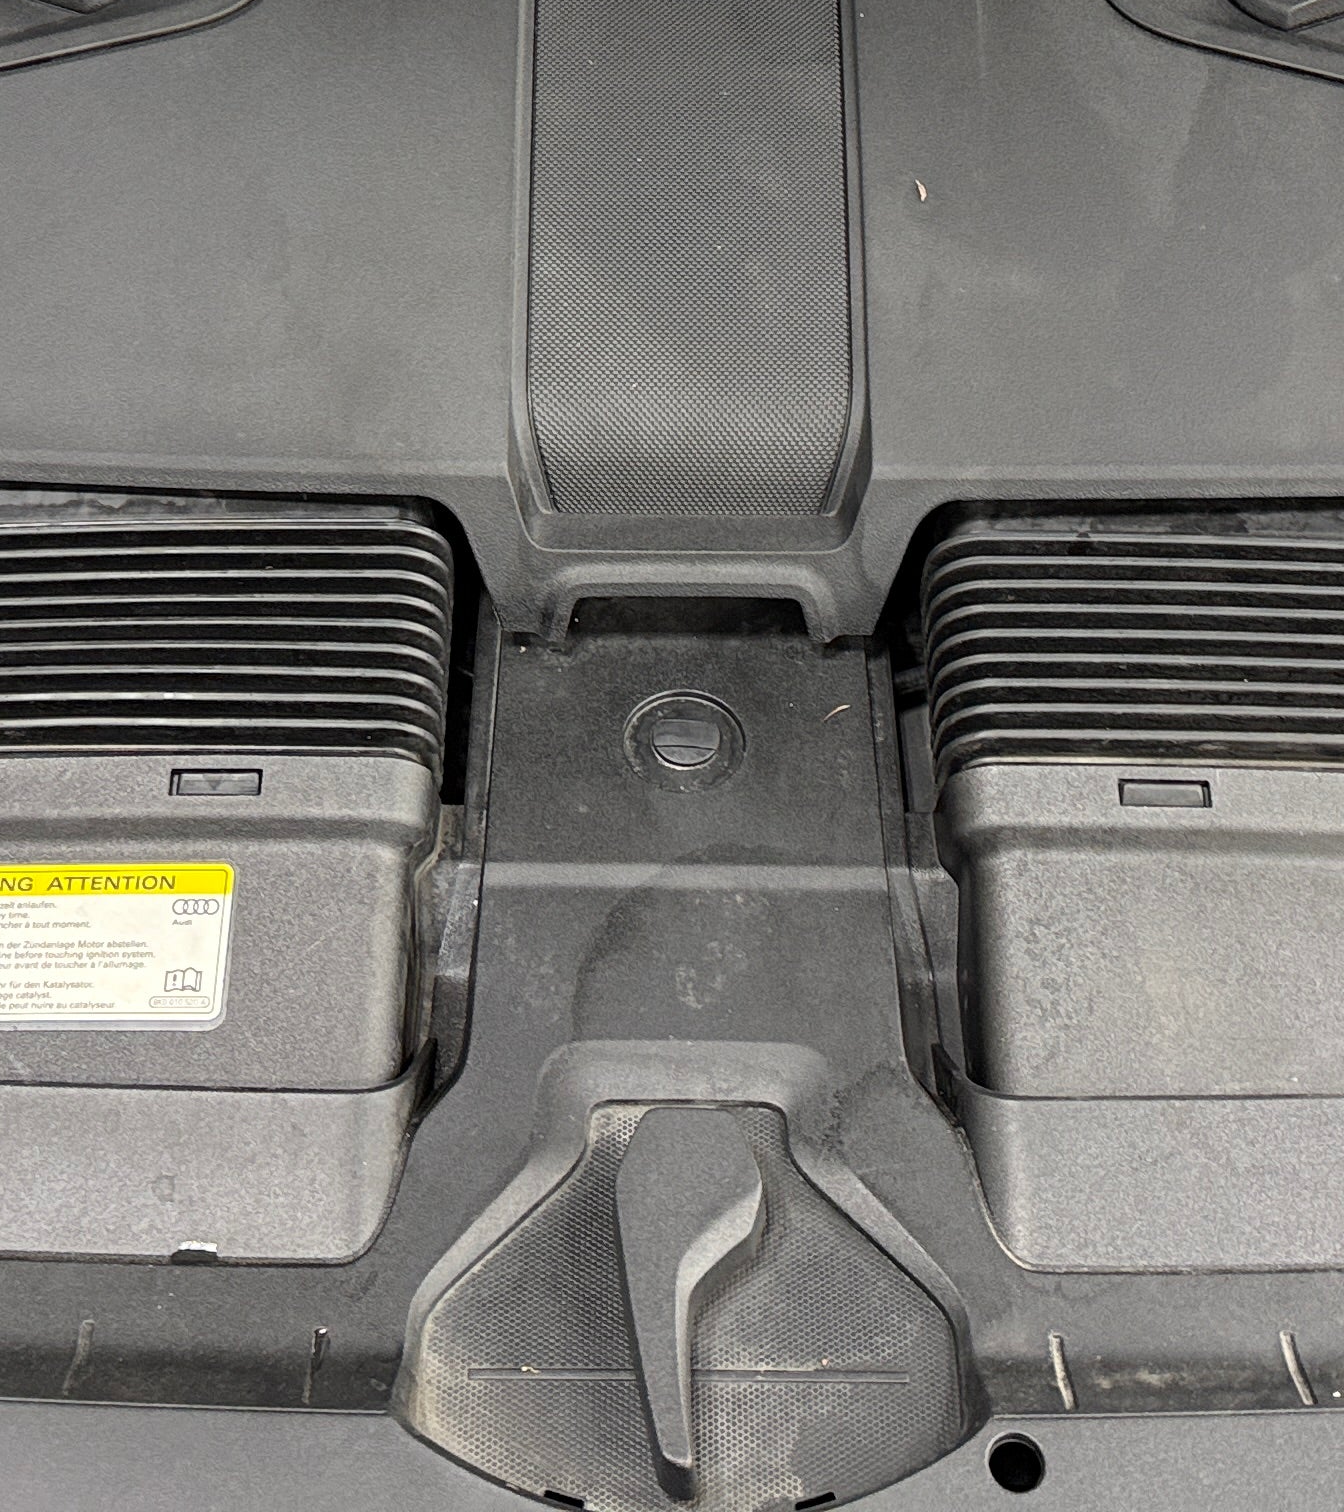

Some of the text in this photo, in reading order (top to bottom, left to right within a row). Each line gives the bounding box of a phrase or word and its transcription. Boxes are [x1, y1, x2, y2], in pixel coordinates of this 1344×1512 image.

[47, 875, 175, 892] ATTENTION
[77, 940, 105, 948] Motor
[14, 951, 43, 959] before
[45, 951, 83, 960] touching
[86, 951, 120, 960] ignition
[121, 951, 156, 959] system.
[14, 961, 39, 969] avant
[41, 961, 52, 969] de
[55, 961, 88, 969] toucher
[9, 980, 22, 989] für
[24, 981, 40, 989] den
[8, 1002, 29, 1011] peut
[31, 1001, 54, 1009] nuire
